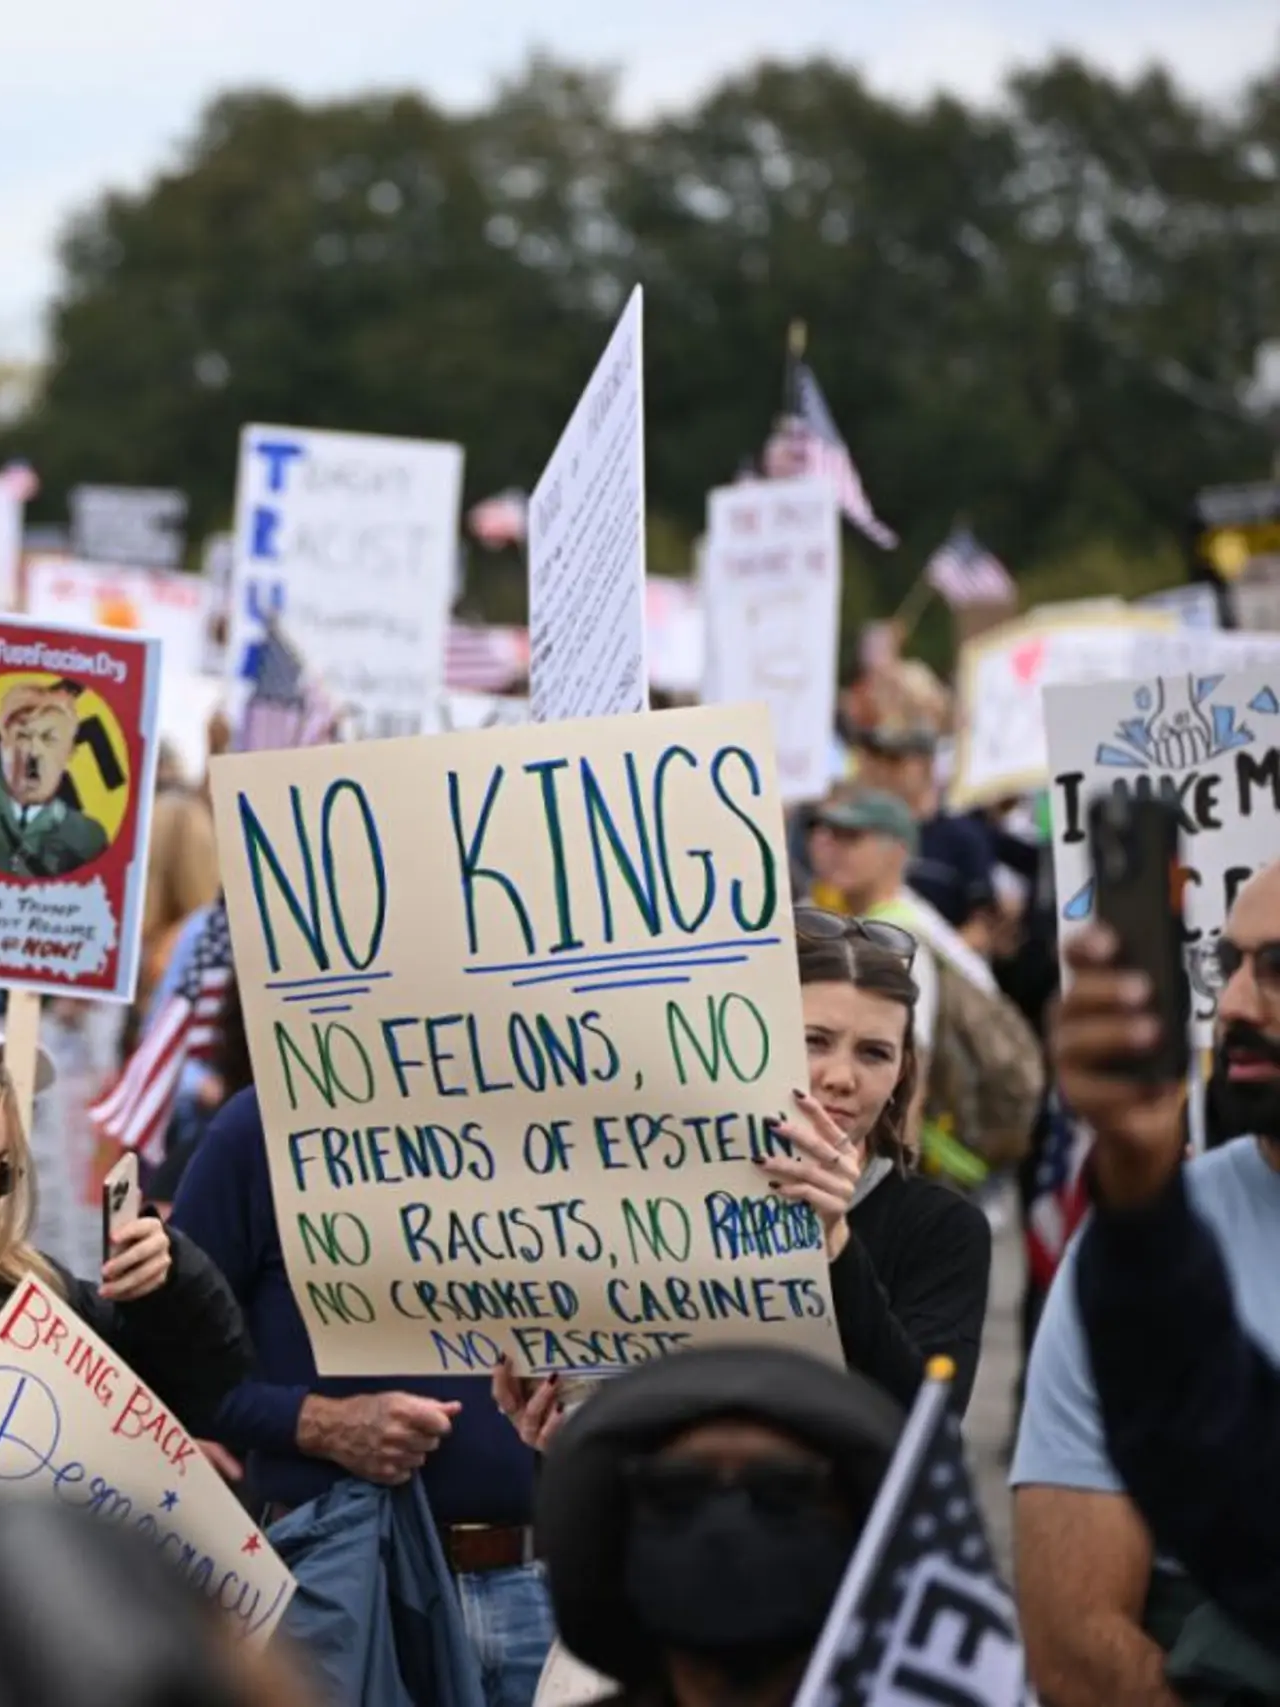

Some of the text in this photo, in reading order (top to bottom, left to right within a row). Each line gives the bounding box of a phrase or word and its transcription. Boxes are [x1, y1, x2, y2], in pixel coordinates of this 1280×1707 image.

[1055, 771, 1086, 844] I
[237, 744, 777, 974] NO KINGS
[18, 896, 82, 918] TRUMP
[273, 991, 771, 1110] NO FELONS, NO
[287, 1121, 496, 1192] FRIENDS
[523, 1121, 577, 1174] OF
[296, 1211, 372, 1267] NO
[398, 1199, 618, 1269] RACISTS,
[622, 1196, 692, 1266] NO
[305, 1280, 377, 1326] NO
[389, 1279, 580, 1325] CROOKED
[430, 1329, 506, 1371] NO
[111, 1383, 197, 1478] BACK
